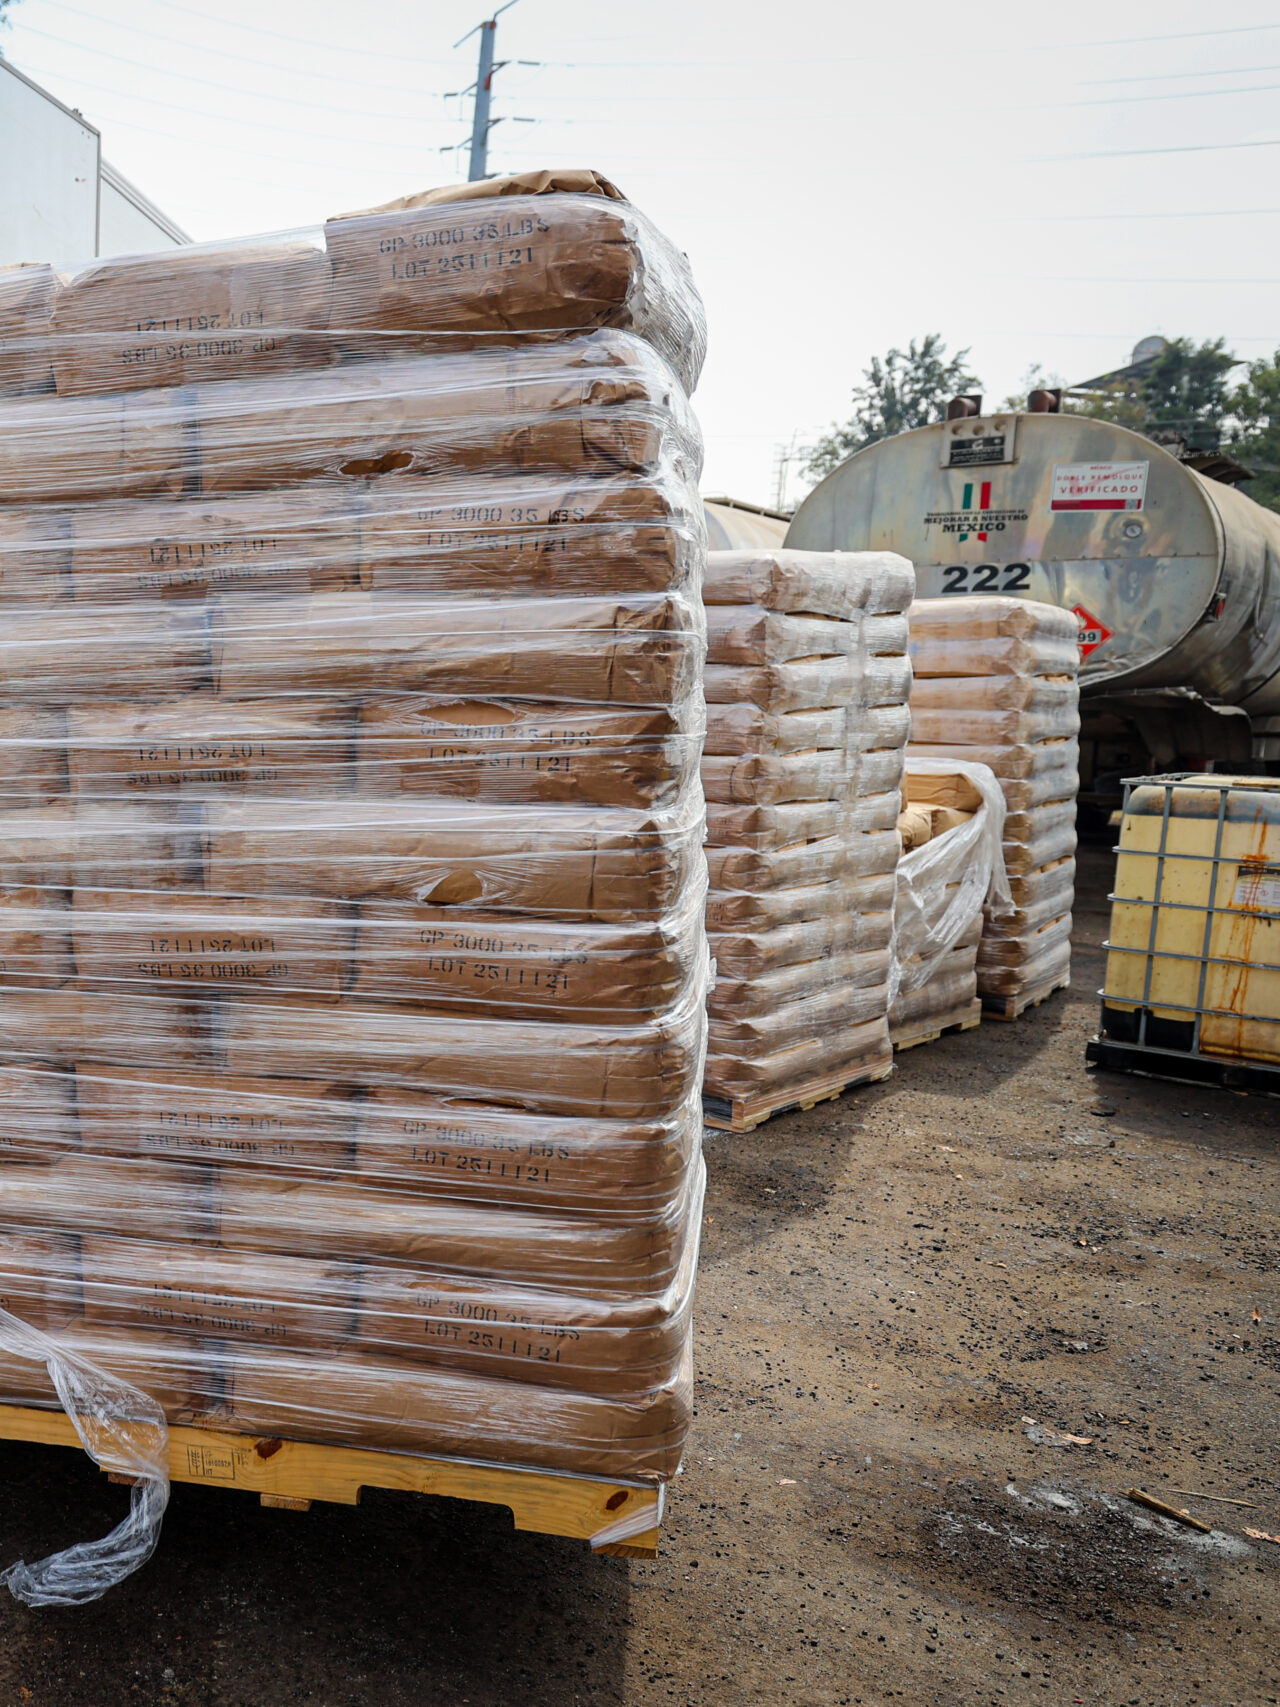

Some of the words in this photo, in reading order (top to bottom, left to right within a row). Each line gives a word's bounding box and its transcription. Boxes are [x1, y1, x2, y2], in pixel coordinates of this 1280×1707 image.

[380, 237, 406, 253] GP
[412, 228, 464, 249] 3000
[506, 218, 550, 237] LBS
[392, 260, 430, 279] LOT
[438, 247, 532, 274] 2511121
[122, 348, 157, 363] LBS
[166, 344, 190, 360] 35
[197, 340, 243, 357] 3000
[1060, 485, 1138, 494] VERIFICADO
[451, 508, 502, 522] 3000
[510, 508, 538, 522] 35
[924, 516, 970, 524] MEJORAR
[943, 522, 1006, 533] MEXICO
[941, 563, 1031, 593] 222
[139, 746, 222, 761] 2511121
[229, 744, 265, 758] LOT
[151, 939, 232, 953] 2511121
[240, 939, 275, 952] LOT
[420, 930, 444, 944] GP
[453, 933, 504, 952] 3000
[138, 963, 172, 977] LBS
[180, 964, 203, 977] 35
[211, 964, 256, 977] 3000
[265, 964, 288, 976] GP
[429, 956, 466, 975] LOT
[474, 964, 567, 989] 2511121
[404, 1120, 427, 1135] GP
[528, 1143, 569, 1160] LBS
[412, 1146, 450, 1166] LOT
[456, 1155, 549, 1183] 2511121
[417, 1294, 439, 1309] GP
[449, 1301, 497, 1321] 3000
[425, 1320, 461, 1340] LOT
[468, 1331, 560, 1362] 2511121
